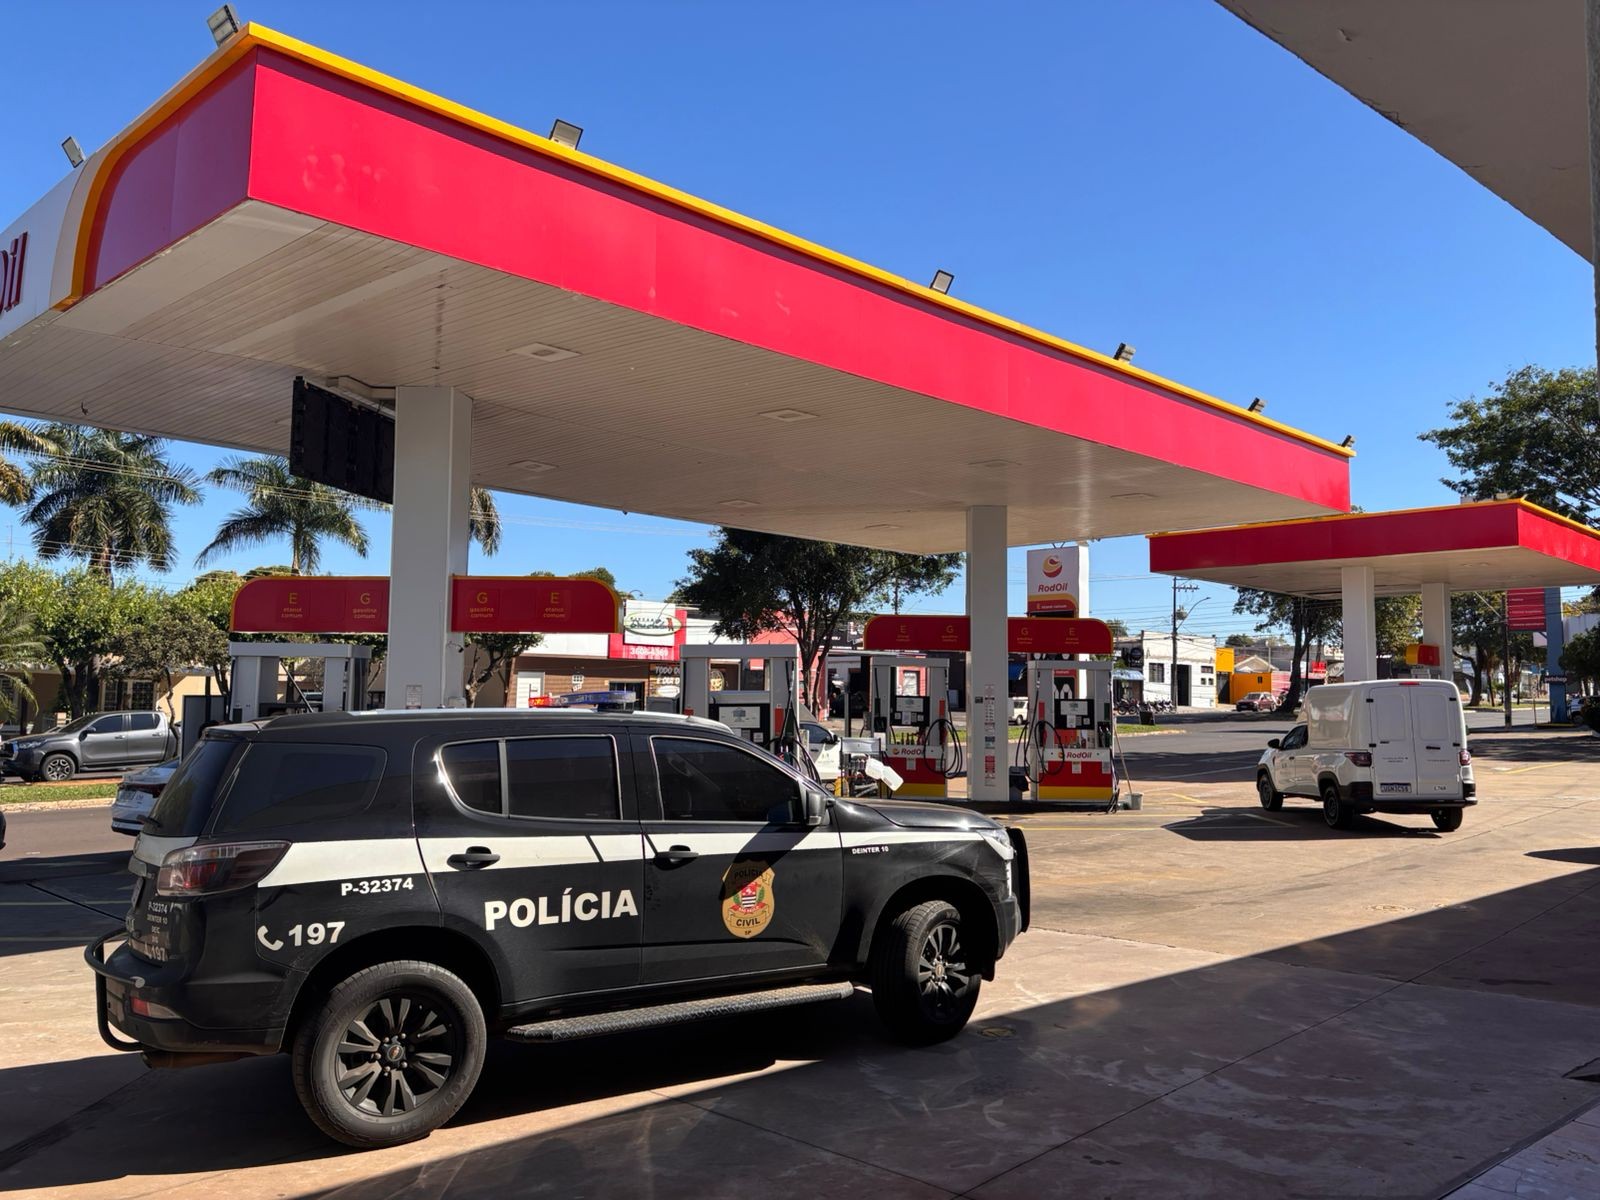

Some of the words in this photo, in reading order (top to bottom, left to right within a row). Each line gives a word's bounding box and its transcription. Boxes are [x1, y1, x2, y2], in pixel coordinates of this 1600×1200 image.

[1038, 583, 1068, 592] RodOil
[288, 592, 298, 604] E
[360, 592, 371, 604] G
[476, 592, 488, 604] G
[550, 592, 560, 604] E
[900, 625, 907, 633] E
[946, 625, 954, 633] G
[1021, 627, 1029, 636] G
[1069, 627, 1076, 636] E
[901, 748, 925, 756] RodO
[1066, 751, 1092, 759] RodOil
[851, 846, 880, 855] DEINTER
[340, 877, 414, 896] P-32374
[484, 888, 639, 931] POLÍCIA
[736, 918, 760, 927] CIVIL
[288, 921, 346, 947] 197
